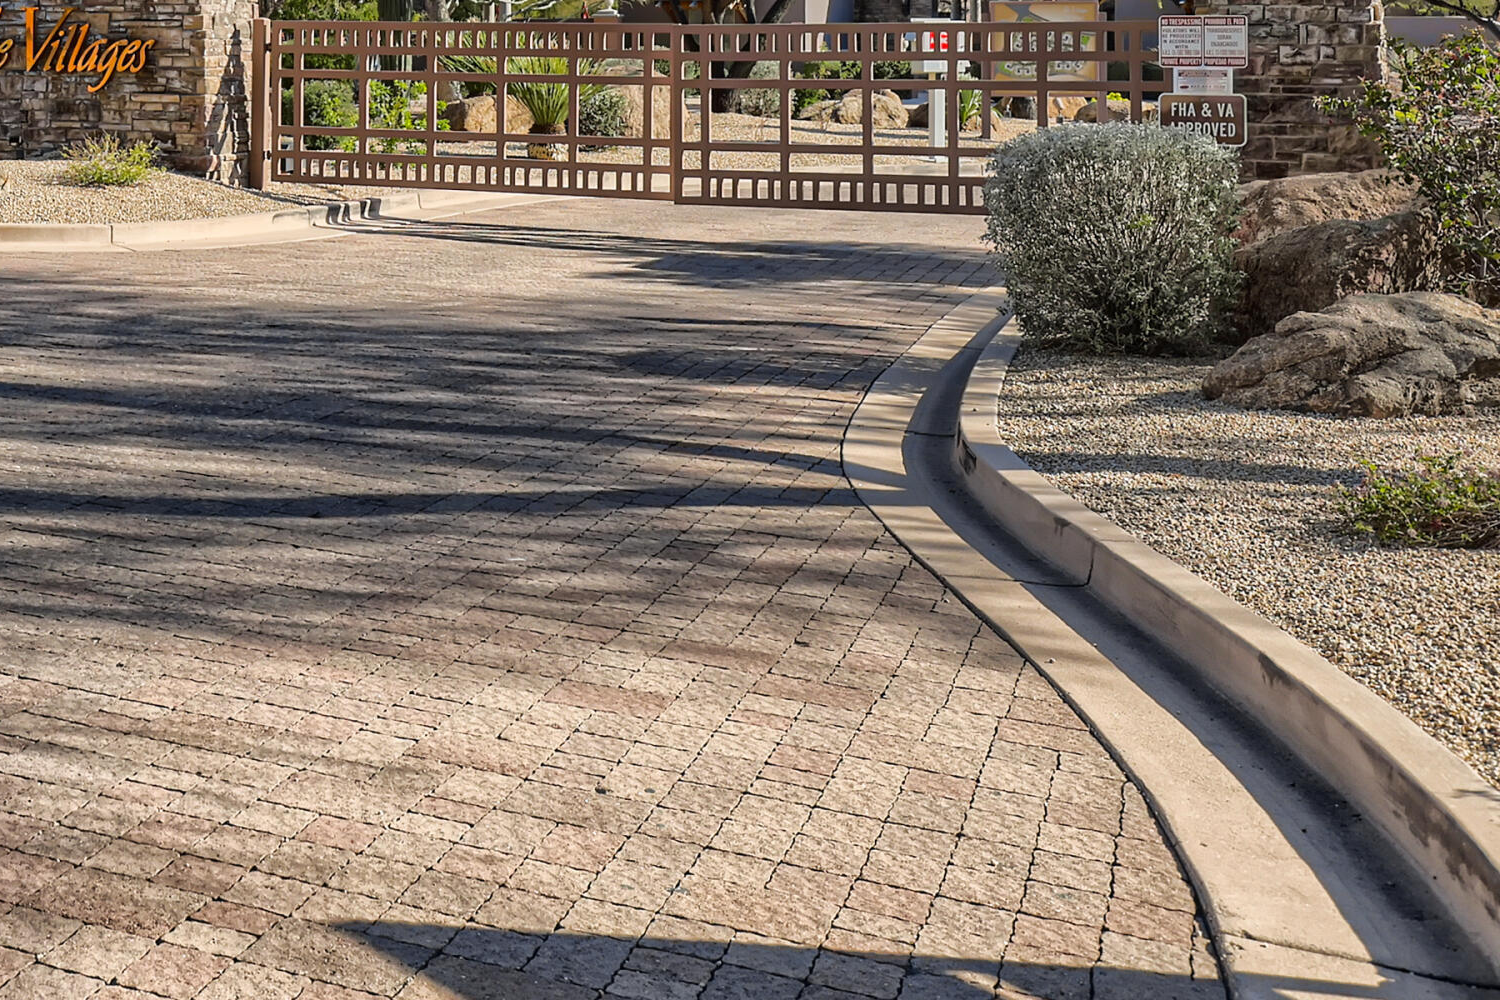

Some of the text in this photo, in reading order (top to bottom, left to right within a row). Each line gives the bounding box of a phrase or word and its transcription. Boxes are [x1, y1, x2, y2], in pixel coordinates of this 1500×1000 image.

[20, 6, 156, 93] Villages
[1171, 102, 1234, 118] FHA & VA
